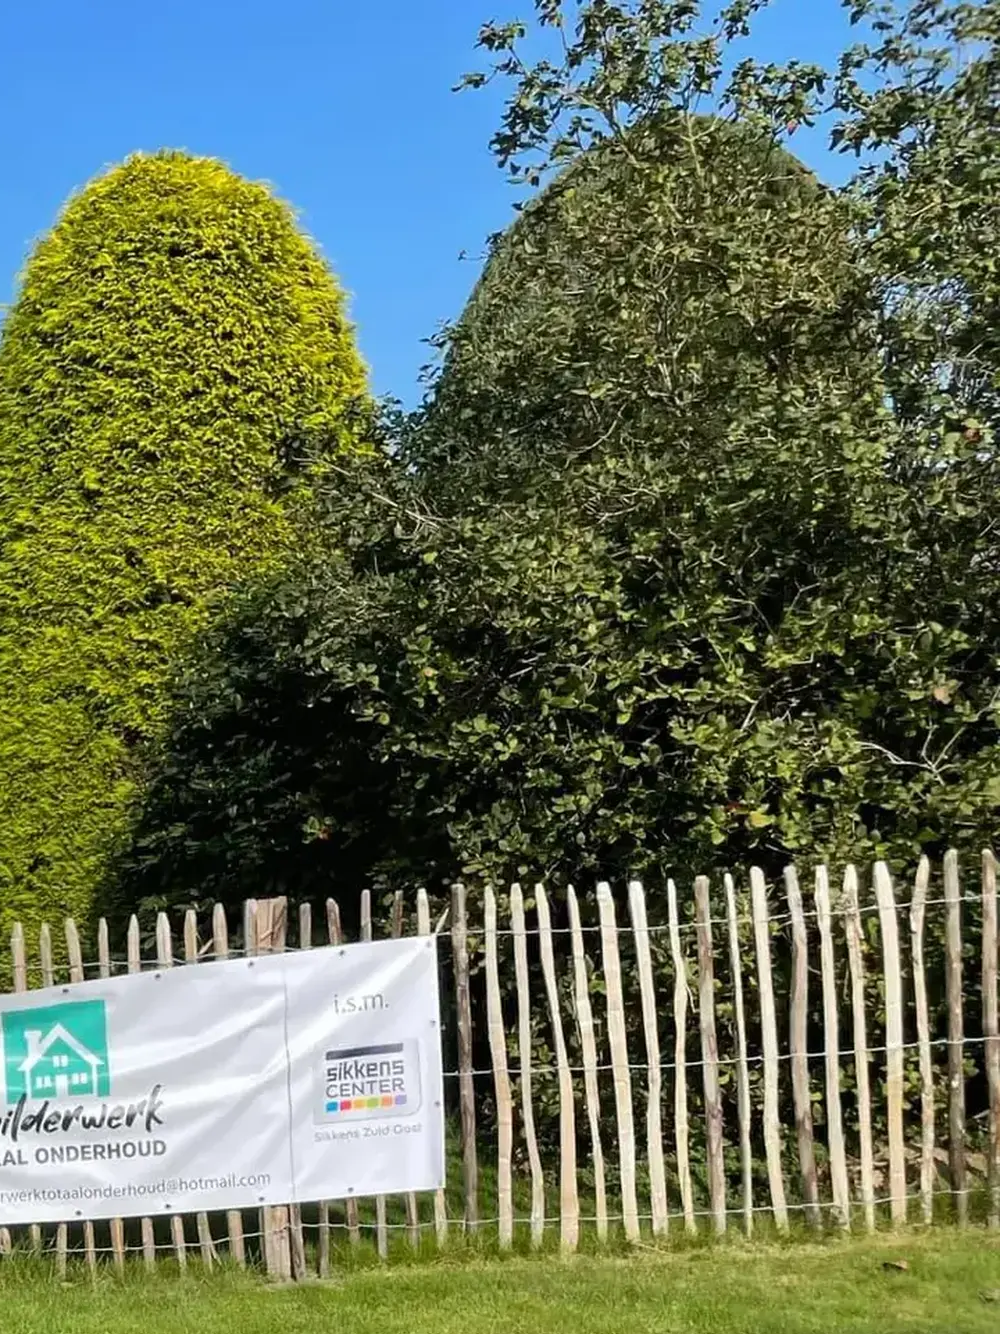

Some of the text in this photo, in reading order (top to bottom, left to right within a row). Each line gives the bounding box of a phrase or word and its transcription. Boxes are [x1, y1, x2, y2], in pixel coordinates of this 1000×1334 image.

[333, 993, 390, 1014] i.s.m.
[327, 1059, 404, 1082] sikkens
[326, 1077, 405, 1098] CENTER
[314, 1130, 359, 1142] Sikkens
[36, 1140, 167, 1164] ONDERHOUD
